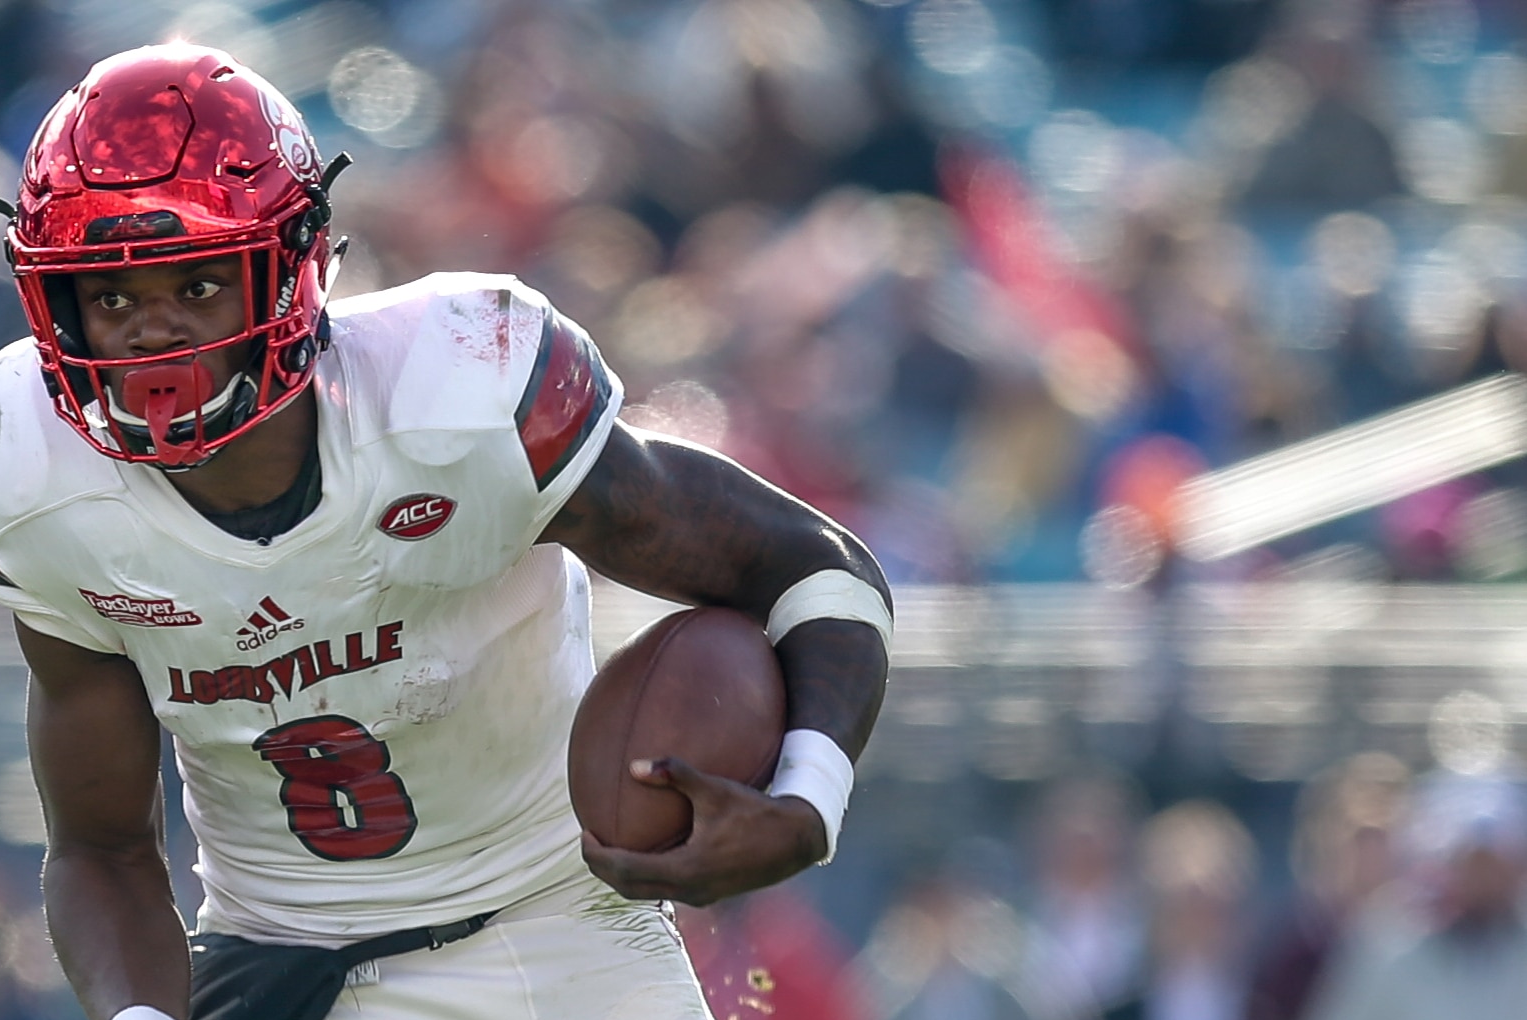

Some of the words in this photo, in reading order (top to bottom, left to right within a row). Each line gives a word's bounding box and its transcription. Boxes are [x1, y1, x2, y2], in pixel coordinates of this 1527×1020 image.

[275, 276, 296, 319] Ridd
[388, 498, 444, 529] ACC
[84, 594, 172, 618] TaxSlayer
[153, 613, 197, 624] BOWL
[236, 618, 305, 652] adidas
[167, 619, 404, 704] LOUISVILLE
[250, 714, 419, 862] 8
